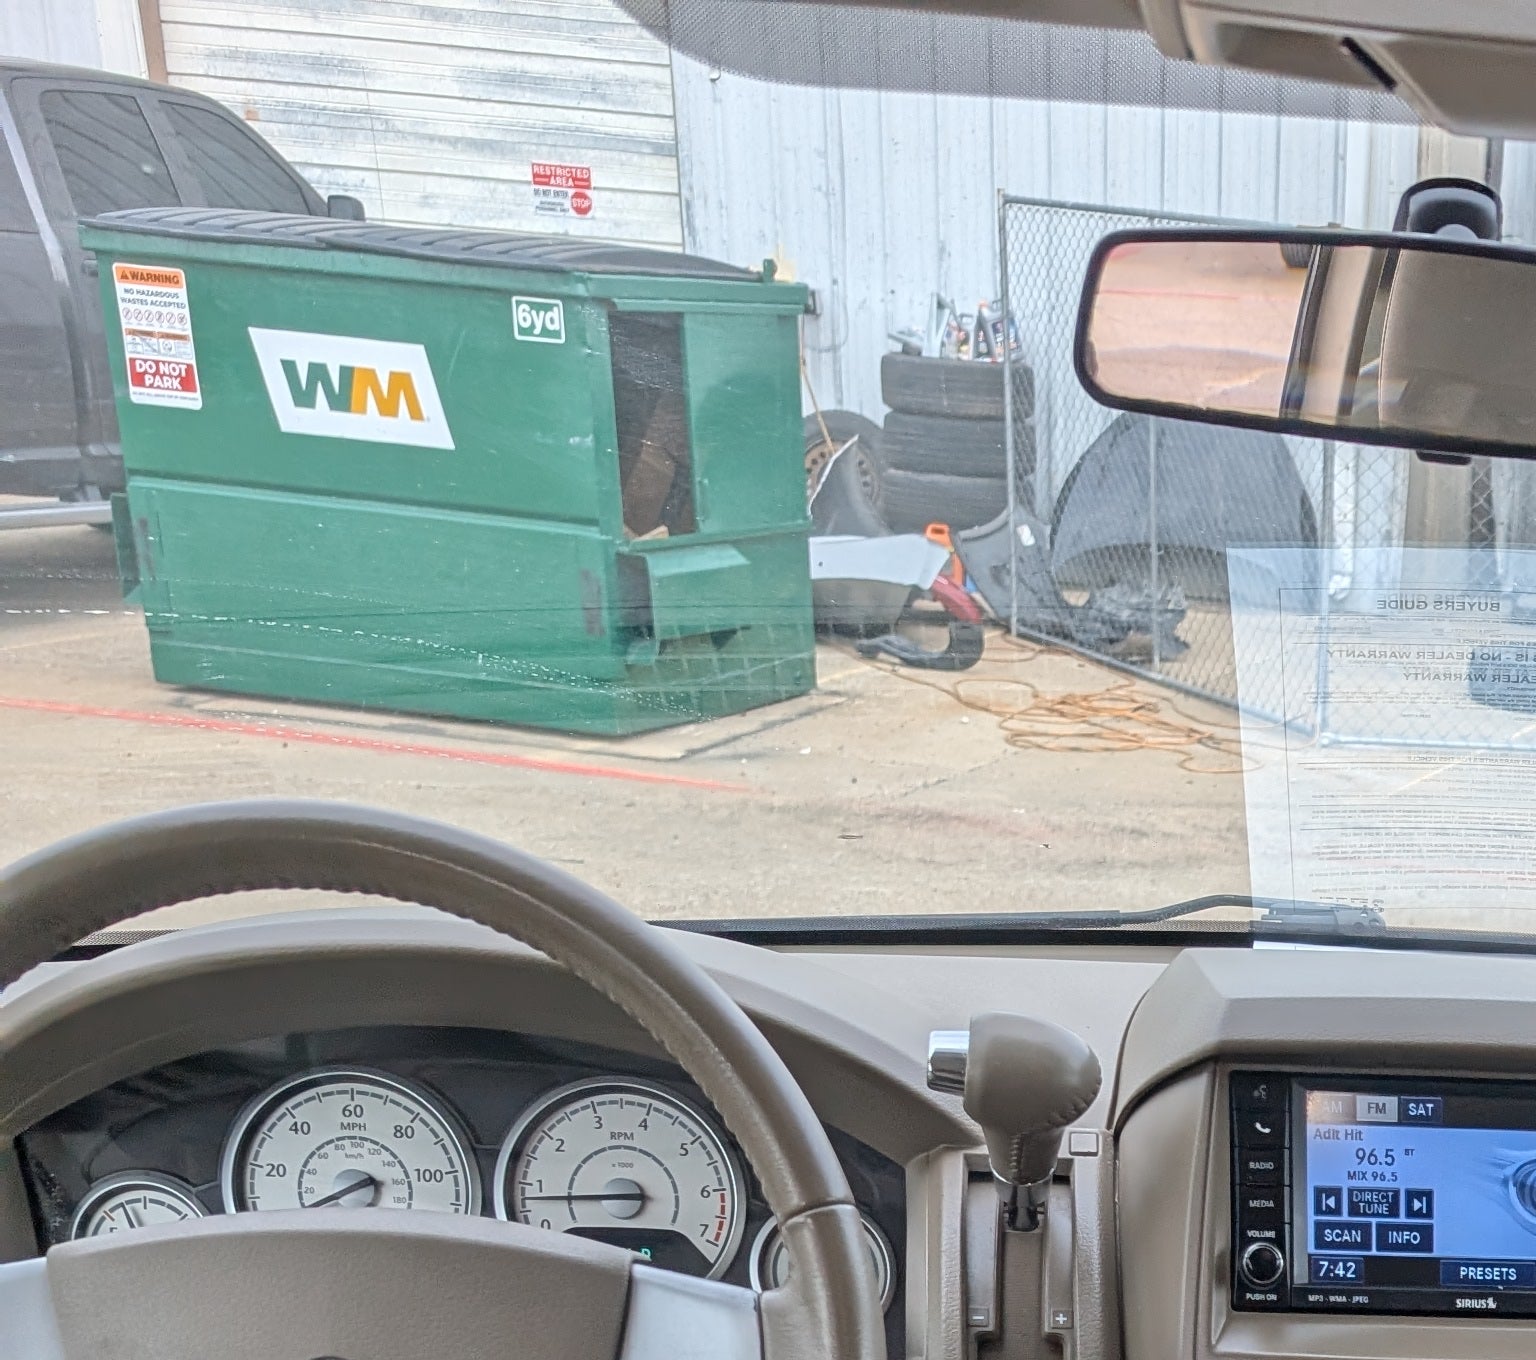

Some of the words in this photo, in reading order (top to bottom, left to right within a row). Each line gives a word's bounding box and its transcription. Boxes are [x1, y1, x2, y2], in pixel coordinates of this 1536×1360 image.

[533, 165, 589, 178] RESTRICTED
[549, 176, 574, 187] AREA
[542, 189, 551, 197] NOT
[572, 197, 591, 209] STOP
[129, 271, 180, 285] WARNING
[123, 287, 135, 296] NO
[136, 289, 180, 299] HAZARDOUS
[120, 297, 149, 306] WASTES
[150, 300, 186, 309] ACCEPTED
[517, 303, 561, 335] 6yd
[135, 360, 157, 374] DO
[158, 364, 187, 377] NOT
[144, 374, 182, 390] PARK
[279, 358, 425, 422] WM
[342, 1104, 364, 1118] 60
[1367, 1102, 1387, 1115] FM
[1408, 1103, 1434, 1116] SAT
[289, 1121, 311, 1135] 40
[340, 1122, 367, 1131] MPH
[594, 1116, 603, 1130] 3
[638, 1119, 648, 1131] 4
[393, 1125, 415, 1139] 80
[610, 1132, 634, 1141] RPM
[1344, 1129, 1364, 1141] Hit
[334, 1143, 346, 1151] 80
[350, 1141, 365, 1149] 100
[555, 1139, 565, 1152] 2
[679, 1143, 689, 1156] 5
[317, 1151, 329, 1160] 60
[367, 1148, 382, 1156] 120
[1355, 1148, 1396, 1167] 96.5
[265, 1163, 287, 1178] 20
[1249, 1161, 1274, 1170] RADIO
[414, 1168, 444, 1183] 100
[1347, 1171, 1368, 1181] MIX
[1371, 1172, 1398, 1182] 96.5
[303, 1186, 315, 1195] 20
[536, 1180, 544, 1193] 1
[700, 1185, 711, 1199] 6
[1352, 1190, 1394, 1203] DIRECT
[1249, 1200, 1275, 1208] MEDIA
[1359, 1203, 1390, 1215] TUNE
[699, 1223, 709, 1238] 7
[1247, 1230, 1276, 1239] VOLUME
[1324, 1229, 1362, 1243] SCAN
[1388, 1231, 1421, 1244] INFO
[1319, 1261, 1356, 1278] 7:42
[1460, 1266, 1517, 1281] PRESETS
[1246, 1293, 1265, 1301] PUSH
[1456, 1298, 1487, 1309] SIRIUS
